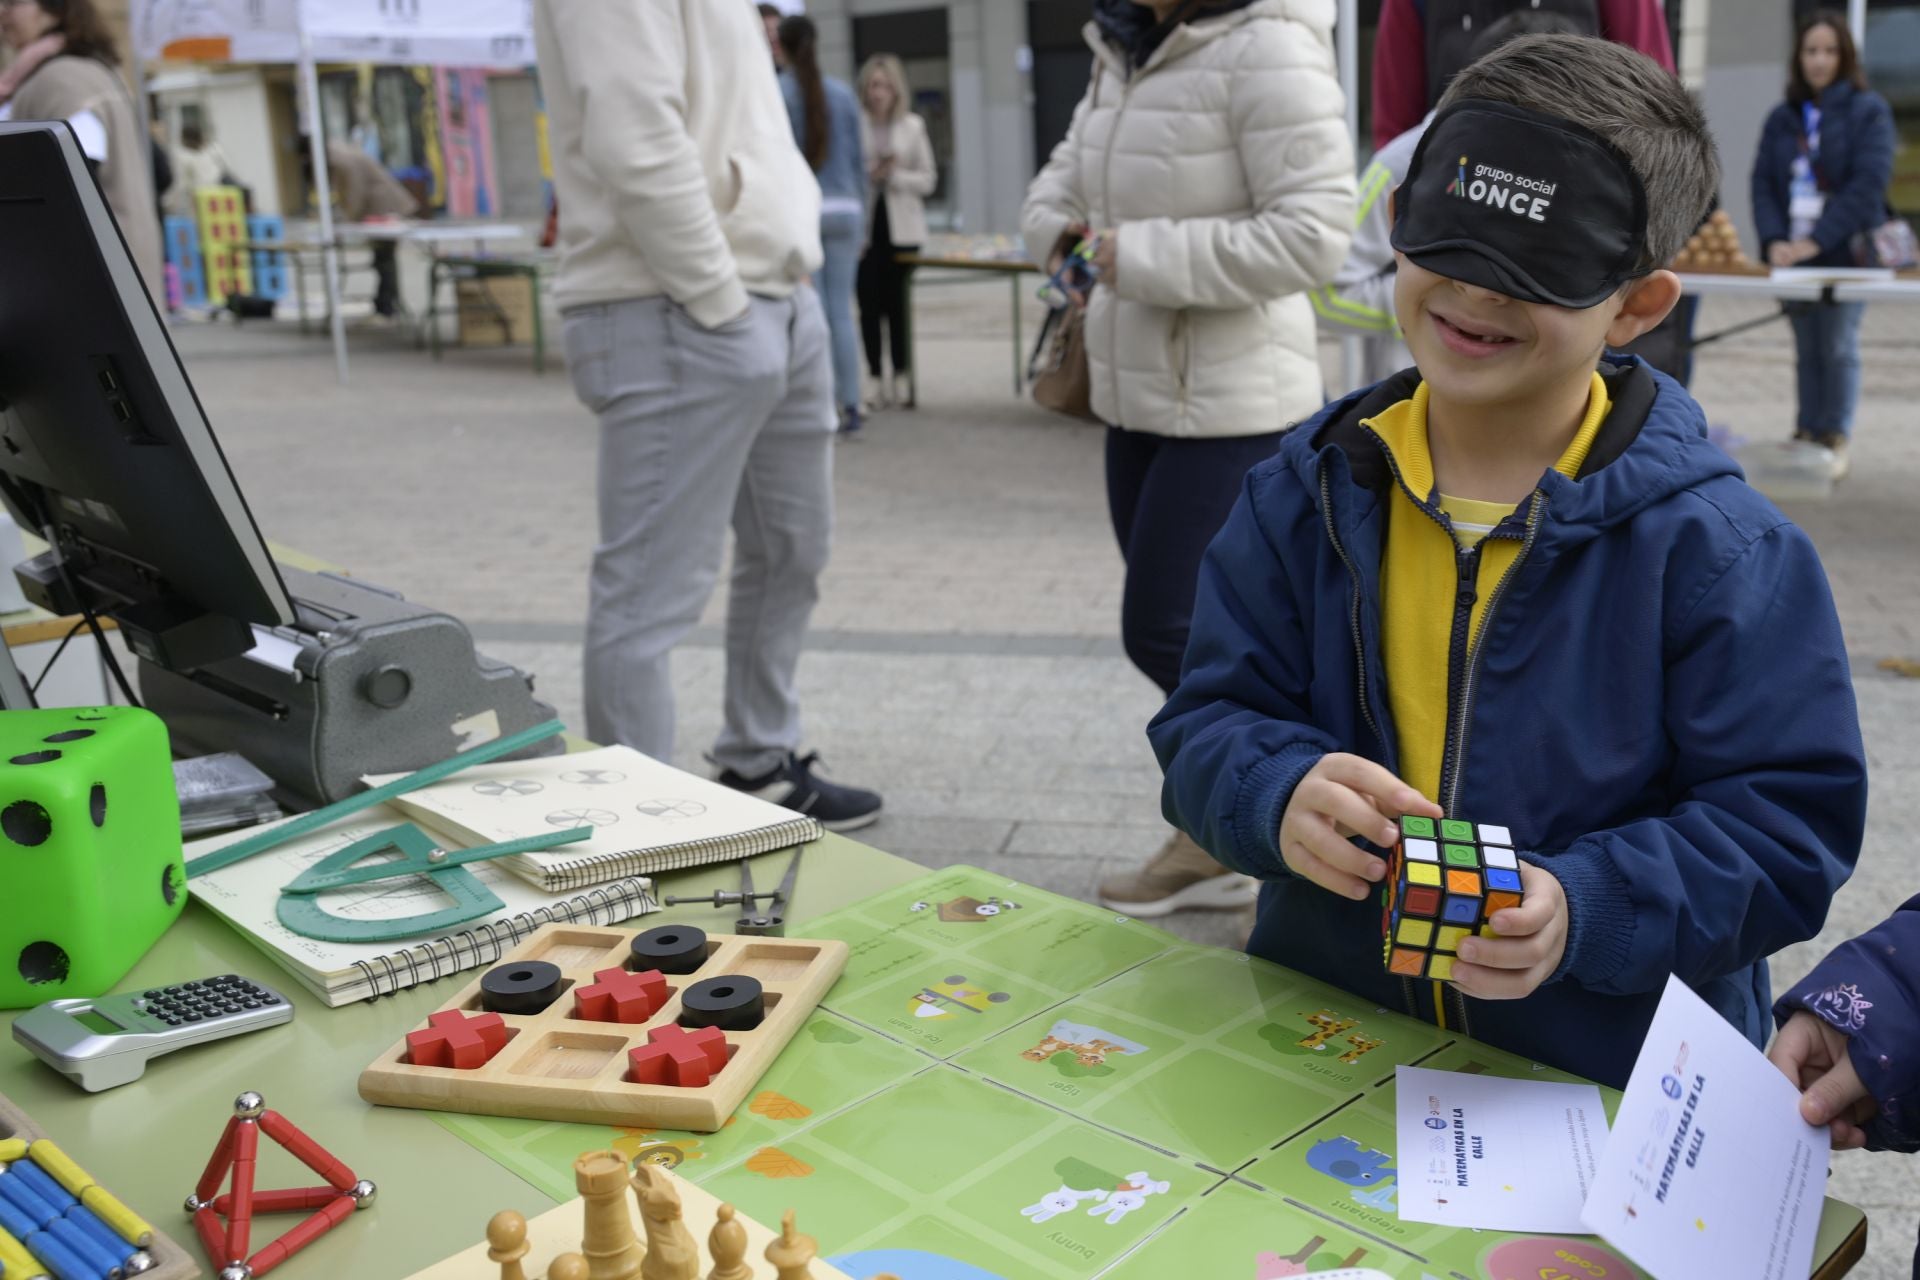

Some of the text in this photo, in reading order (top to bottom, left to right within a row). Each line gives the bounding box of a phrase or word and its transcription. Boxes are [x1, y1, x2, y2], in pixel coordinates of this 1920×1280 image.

[1474, 164, 1557, 196] grupo social
[1468, 179, 1551, 222] ONCE
[887, 1016, 924, 1035] cream
[1303, 1062, 1354, 1083] giraffe
[1047, 1081, 1081, 1097] tiger
[1686, 1091, 1700, 1113] EN
[1693, 1073, 1706, 1093] LA
[1452, 1108, 1469, 1187] MATEMÁTICAS EN LA
[1471, 1135, 1484, 1160] CALLE
[1685, 1127, 1706, 1170] CALLE
[1331, 1200, 1406, 1235] elephant
[1045, 1231, 1097, 1261] bunny
[1555, 1249, 1607, 1277] Code
